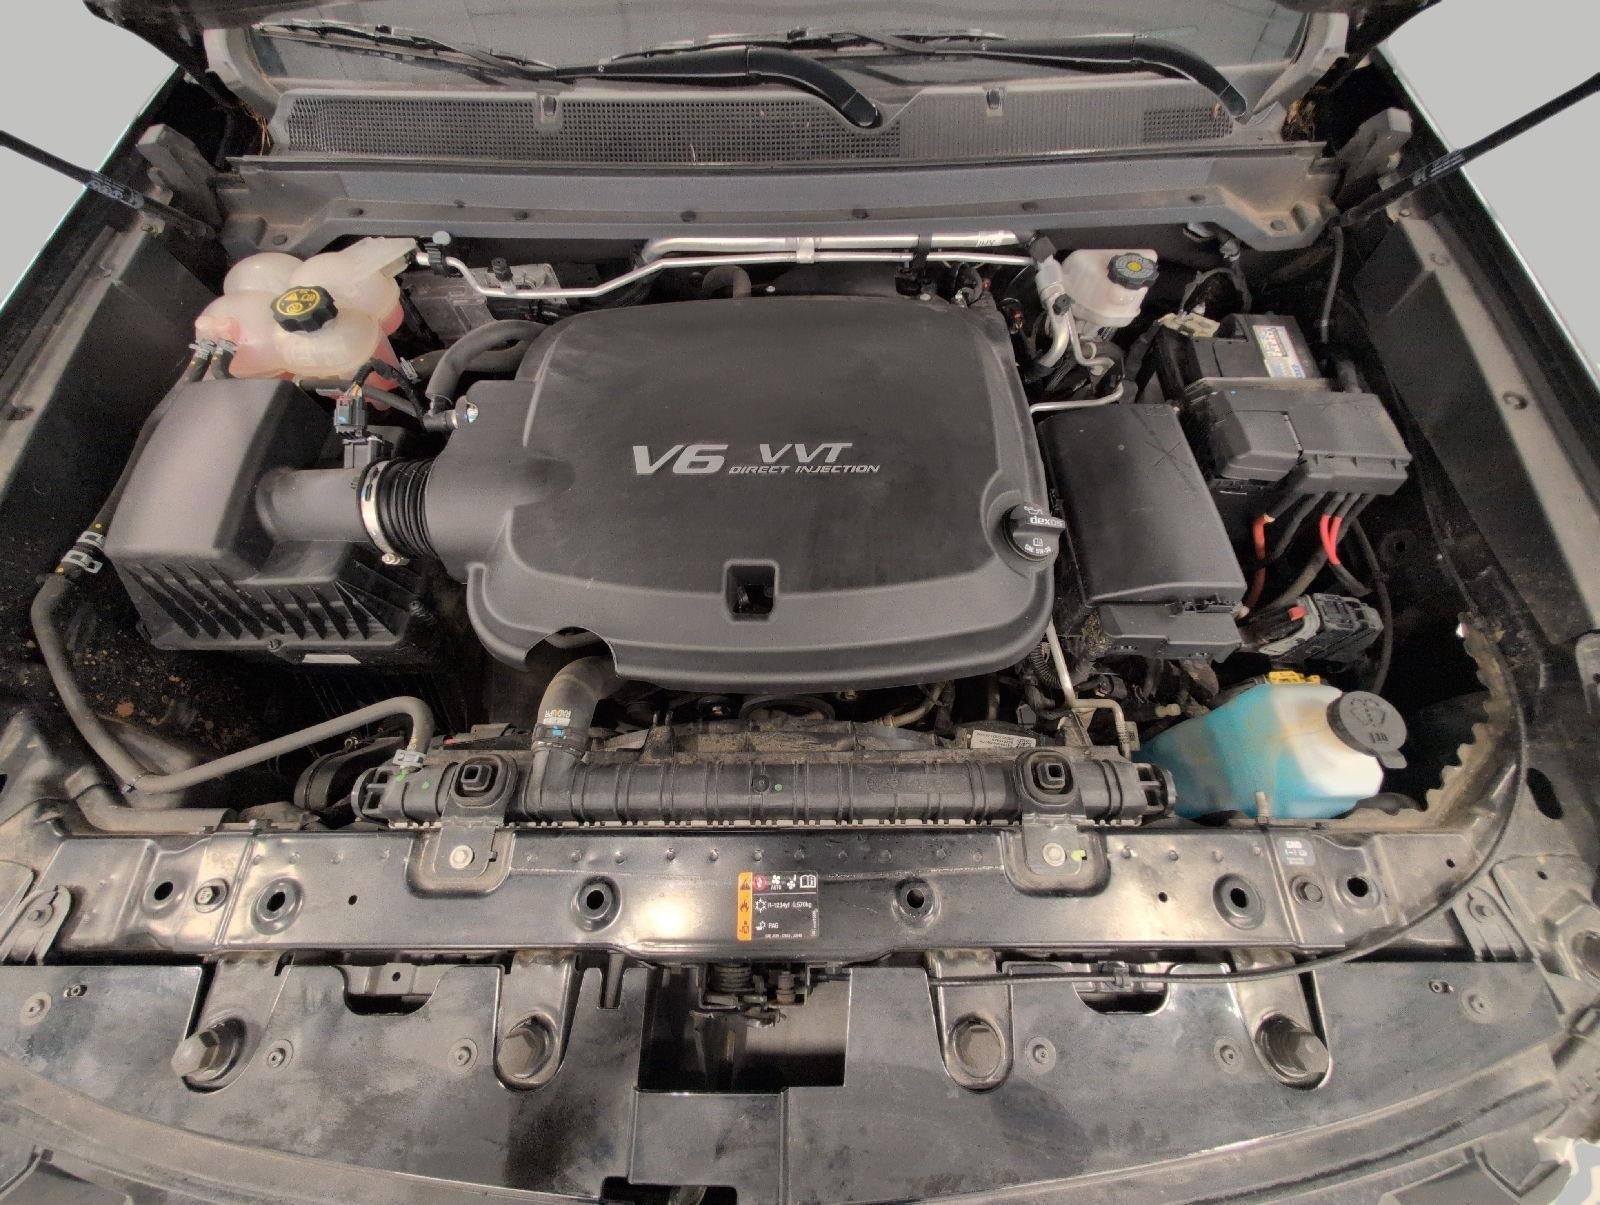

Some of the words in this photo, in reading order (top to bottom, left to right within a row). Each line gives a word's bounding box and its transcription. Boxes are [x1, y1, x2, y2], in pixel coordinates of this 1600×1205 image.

[632, 444, 729, 474] V6
[759, 442, 853, 463] VVT
[728, 465, 791, 475] DIRECT
[794, 464, 880, 474] INJECTION
[1030, 515, 1063, 527] dexos
